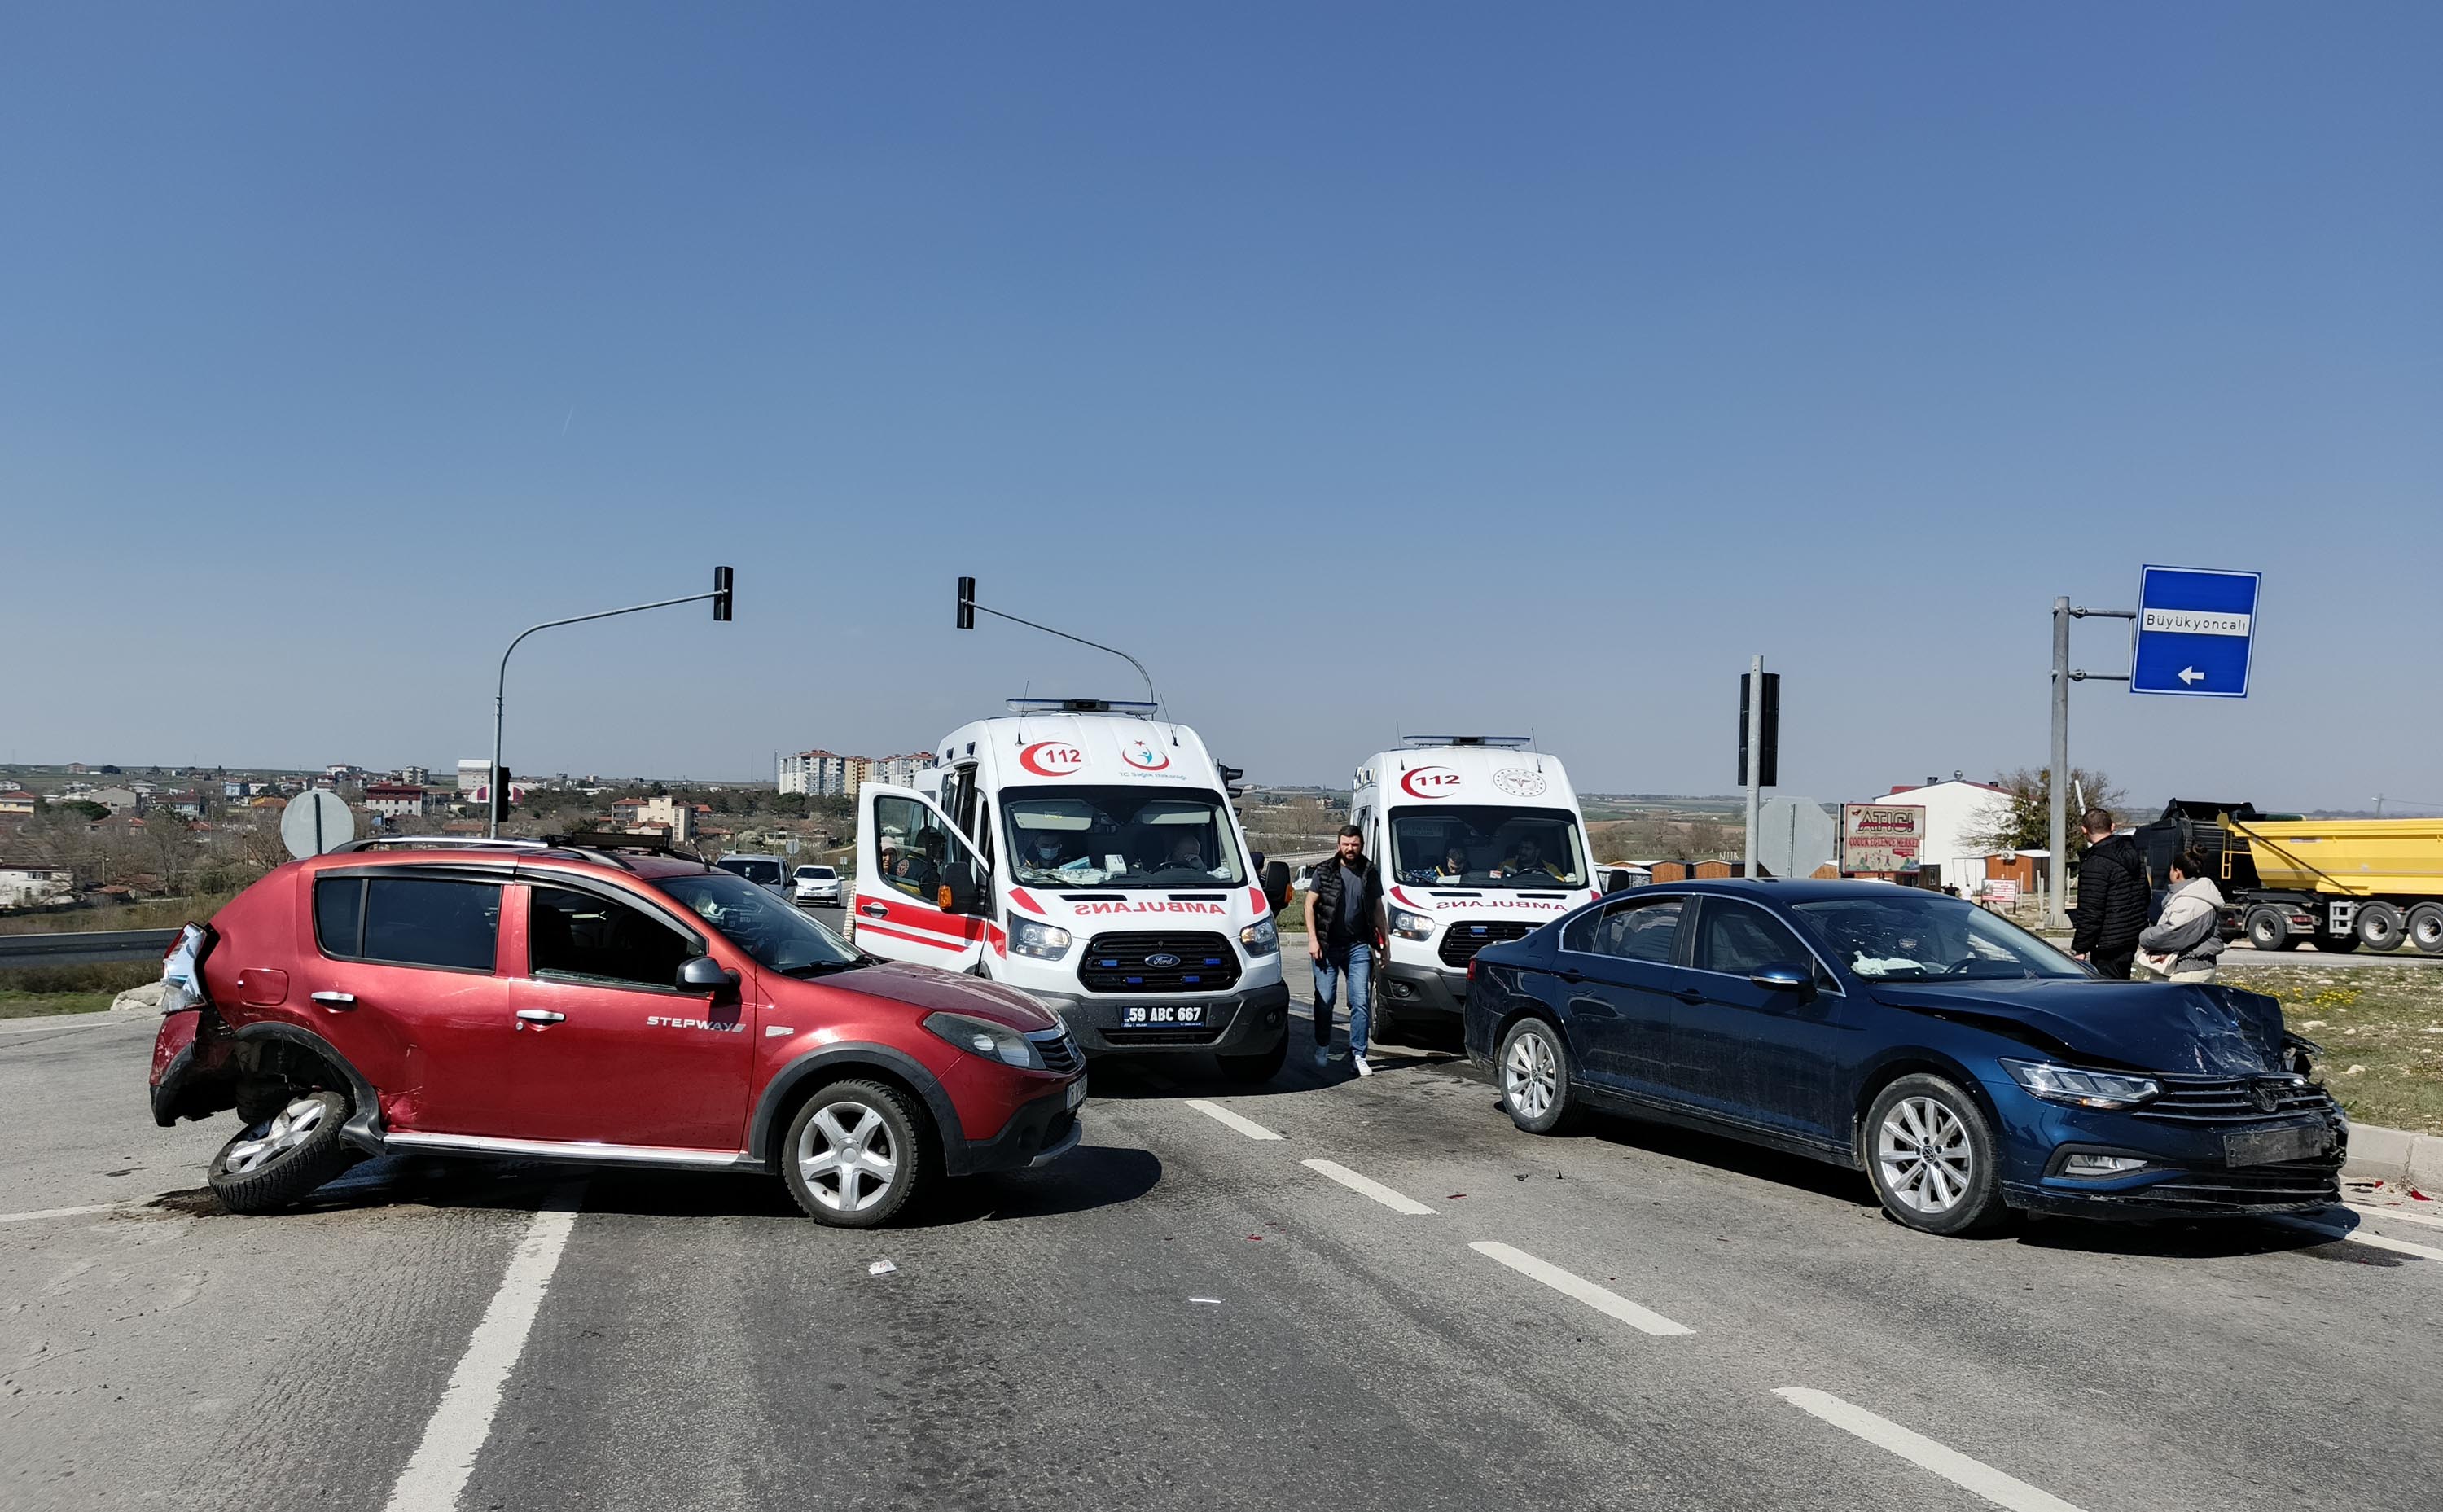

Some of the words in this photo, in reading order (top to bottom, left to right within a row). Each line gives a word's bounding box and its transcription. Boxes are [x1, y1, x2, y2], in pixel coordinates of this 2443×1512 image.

[2147, 614, 2246, 631] Büyükyoncalı
[1046, 749, 1081, 763] 112
[1415, 774, 1461, 787] 112
[1858, 810, 1914, 833] ATICI
[1153, 955, 1173, 966] Ford
[1129, 1007, 1146, 1022] 59
[1150, 1007, 1174, 1022] ABC
[1178, 1006, 1202, 1021] 667
[647, 1015, 734, 1032] STEPWAY
